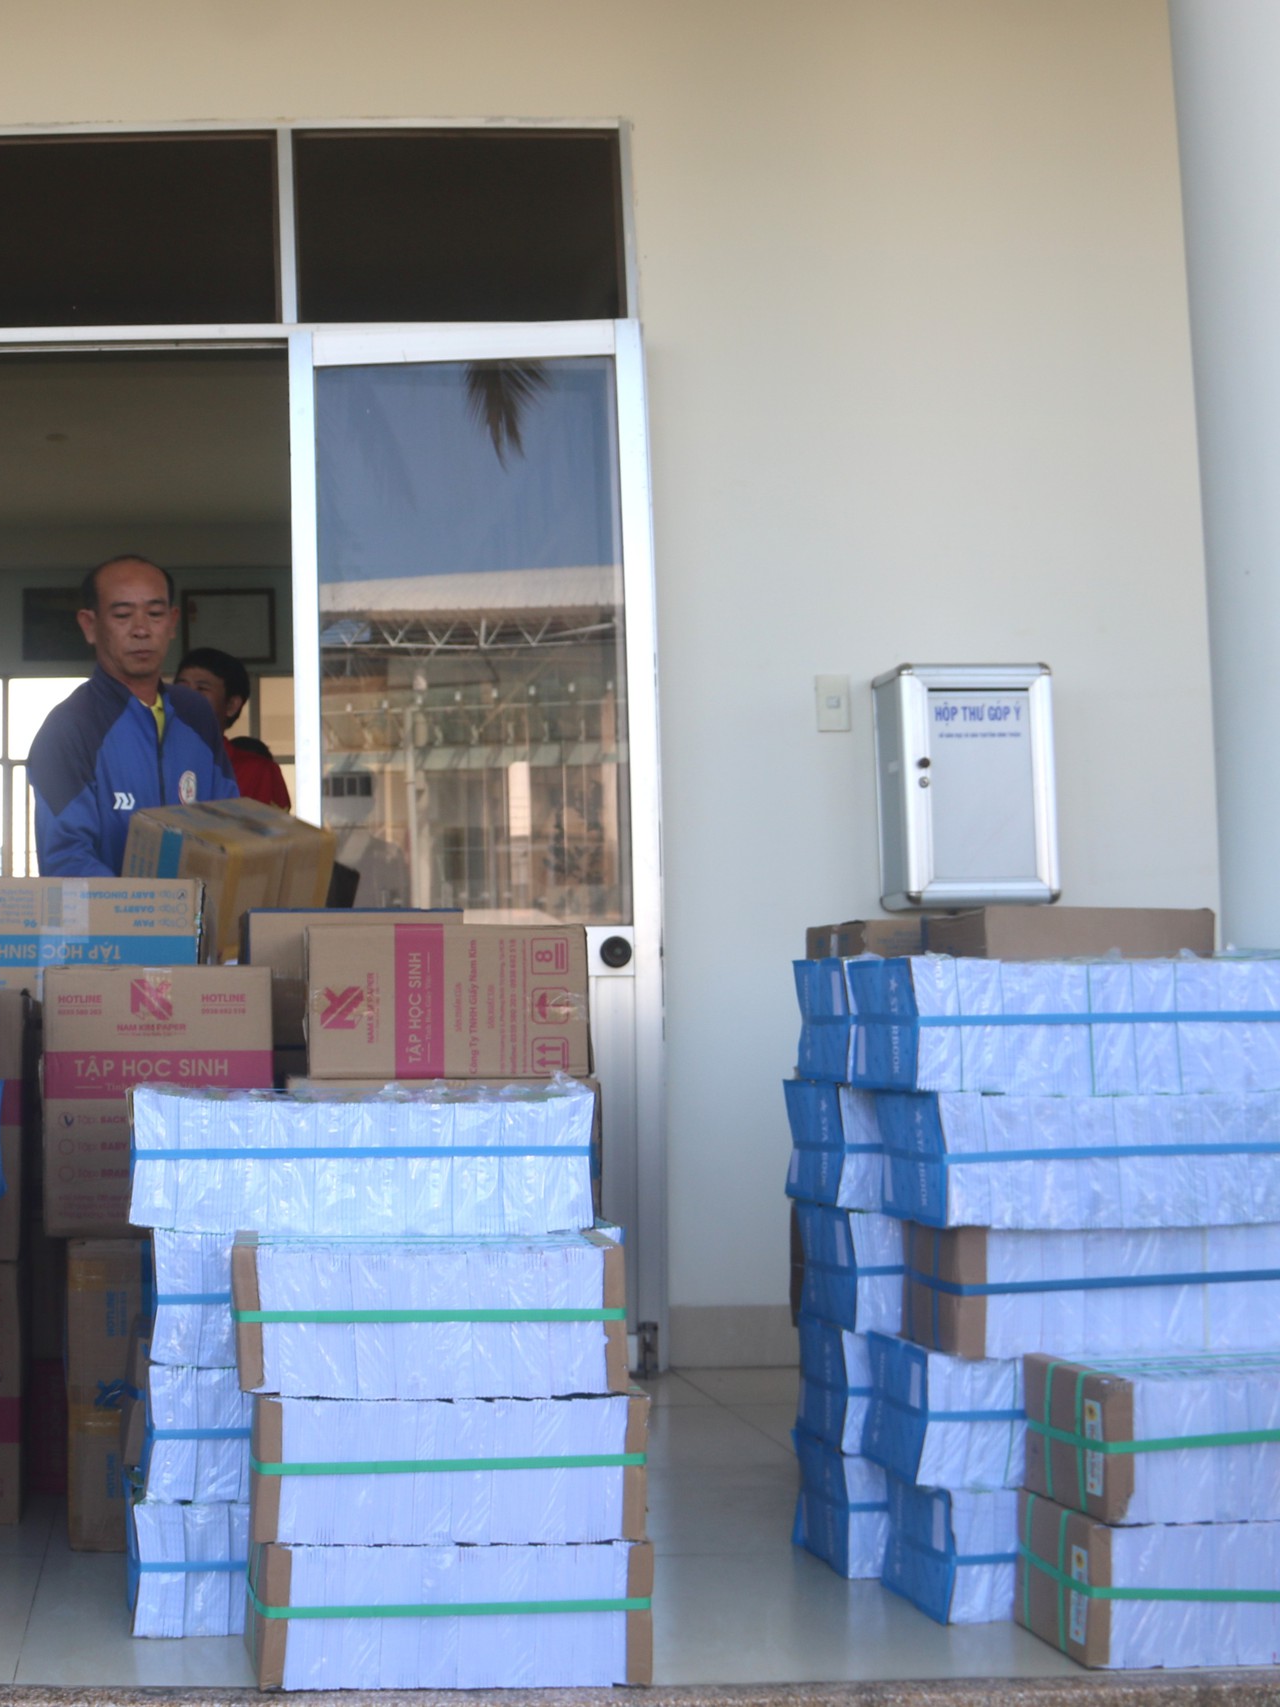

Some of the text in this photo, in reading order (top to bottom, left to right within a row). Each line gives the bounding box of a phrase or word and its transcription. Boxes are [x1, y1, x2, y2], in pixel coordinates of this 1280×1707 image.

[934, 701, 958, 726] HỘP
[961, 703, 985, 722] THƯ
[987, 700, 1011, 722] GÓP
[40, 943, 83, 959] HỌC
[88, 942, 121, 962] TẬP
[535, 950, 553, 963] 8
[58, 994, 103, 1004] HOTLINE
[201, 993, 247, 1002] HOTLINE
[405, 952, 425, 1064] TẬP HỌC SINH
[468, 940, 479, 1074] Công Ty TNHH Giấy Nam Kim
[117, 1024, 136, 1032] NAM
[75, 1055, 228, 1081] TẬP HỌC SINH
